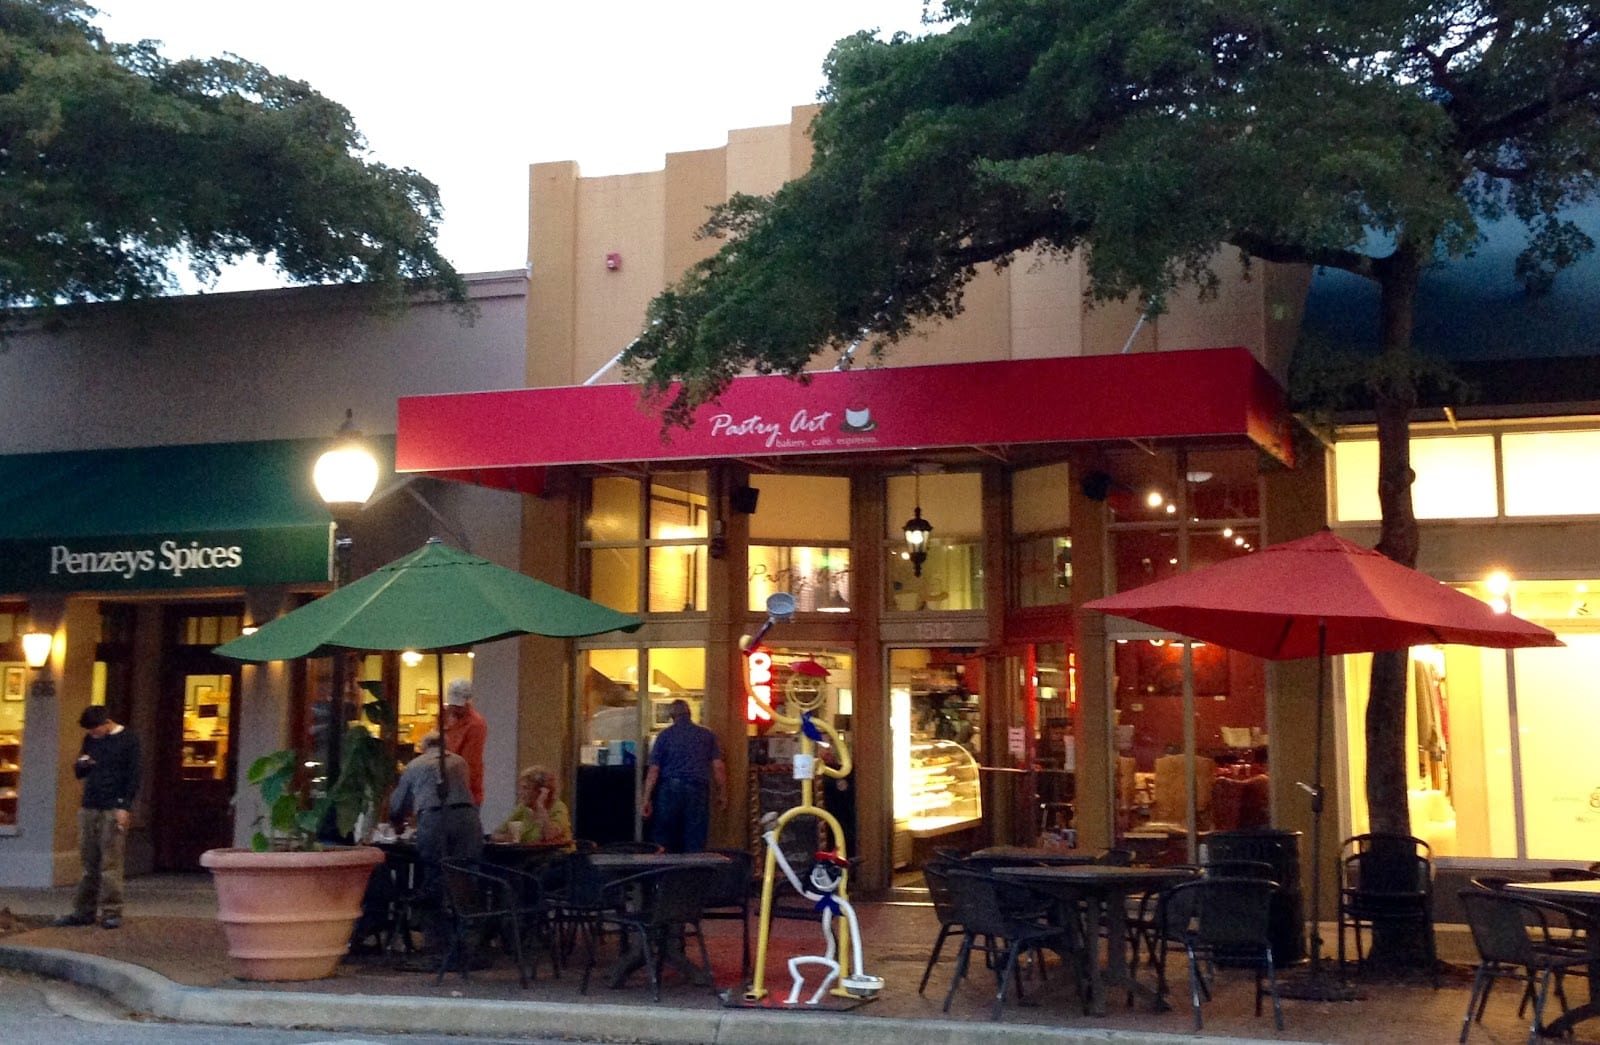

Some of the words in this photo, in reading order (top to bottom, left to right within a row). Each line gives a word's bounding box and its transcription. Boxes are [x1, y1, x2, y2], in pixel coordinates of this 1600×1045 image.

[709, 413, 782, 447] Pastry
[790, 409, 832, 432] Art
[50, 545, 155, 579] Penzeys
[159, 540, 242, 576] Spices
